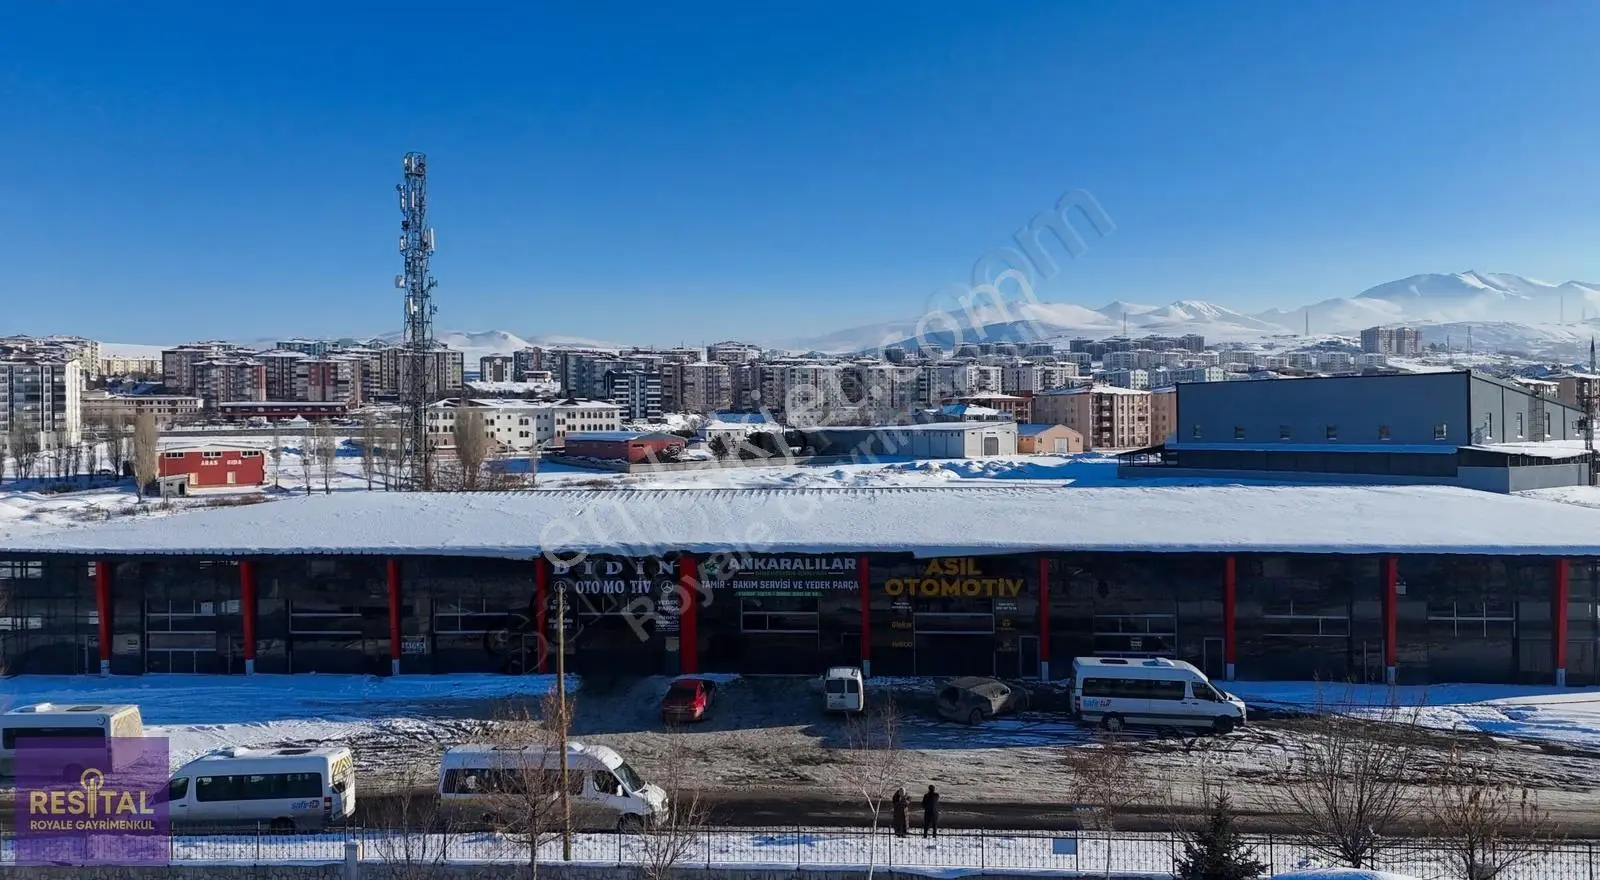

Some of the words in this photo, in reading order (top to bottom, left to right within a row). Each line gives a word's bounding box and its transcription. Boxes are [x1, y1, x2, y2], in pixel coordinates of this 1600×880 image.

[728, 558, 857, 570] ANKARALILAR
[732, 579, 758, 589] BAKIM
[760, 578, 791, 589] SERVİSİ
[793, 579, 803, 589] VE
[804, 579, 831, 589] YEDEK
[832, 579, 859, 591] PARÇA
[884, 578, 1024, 597] OTOMOTİV
